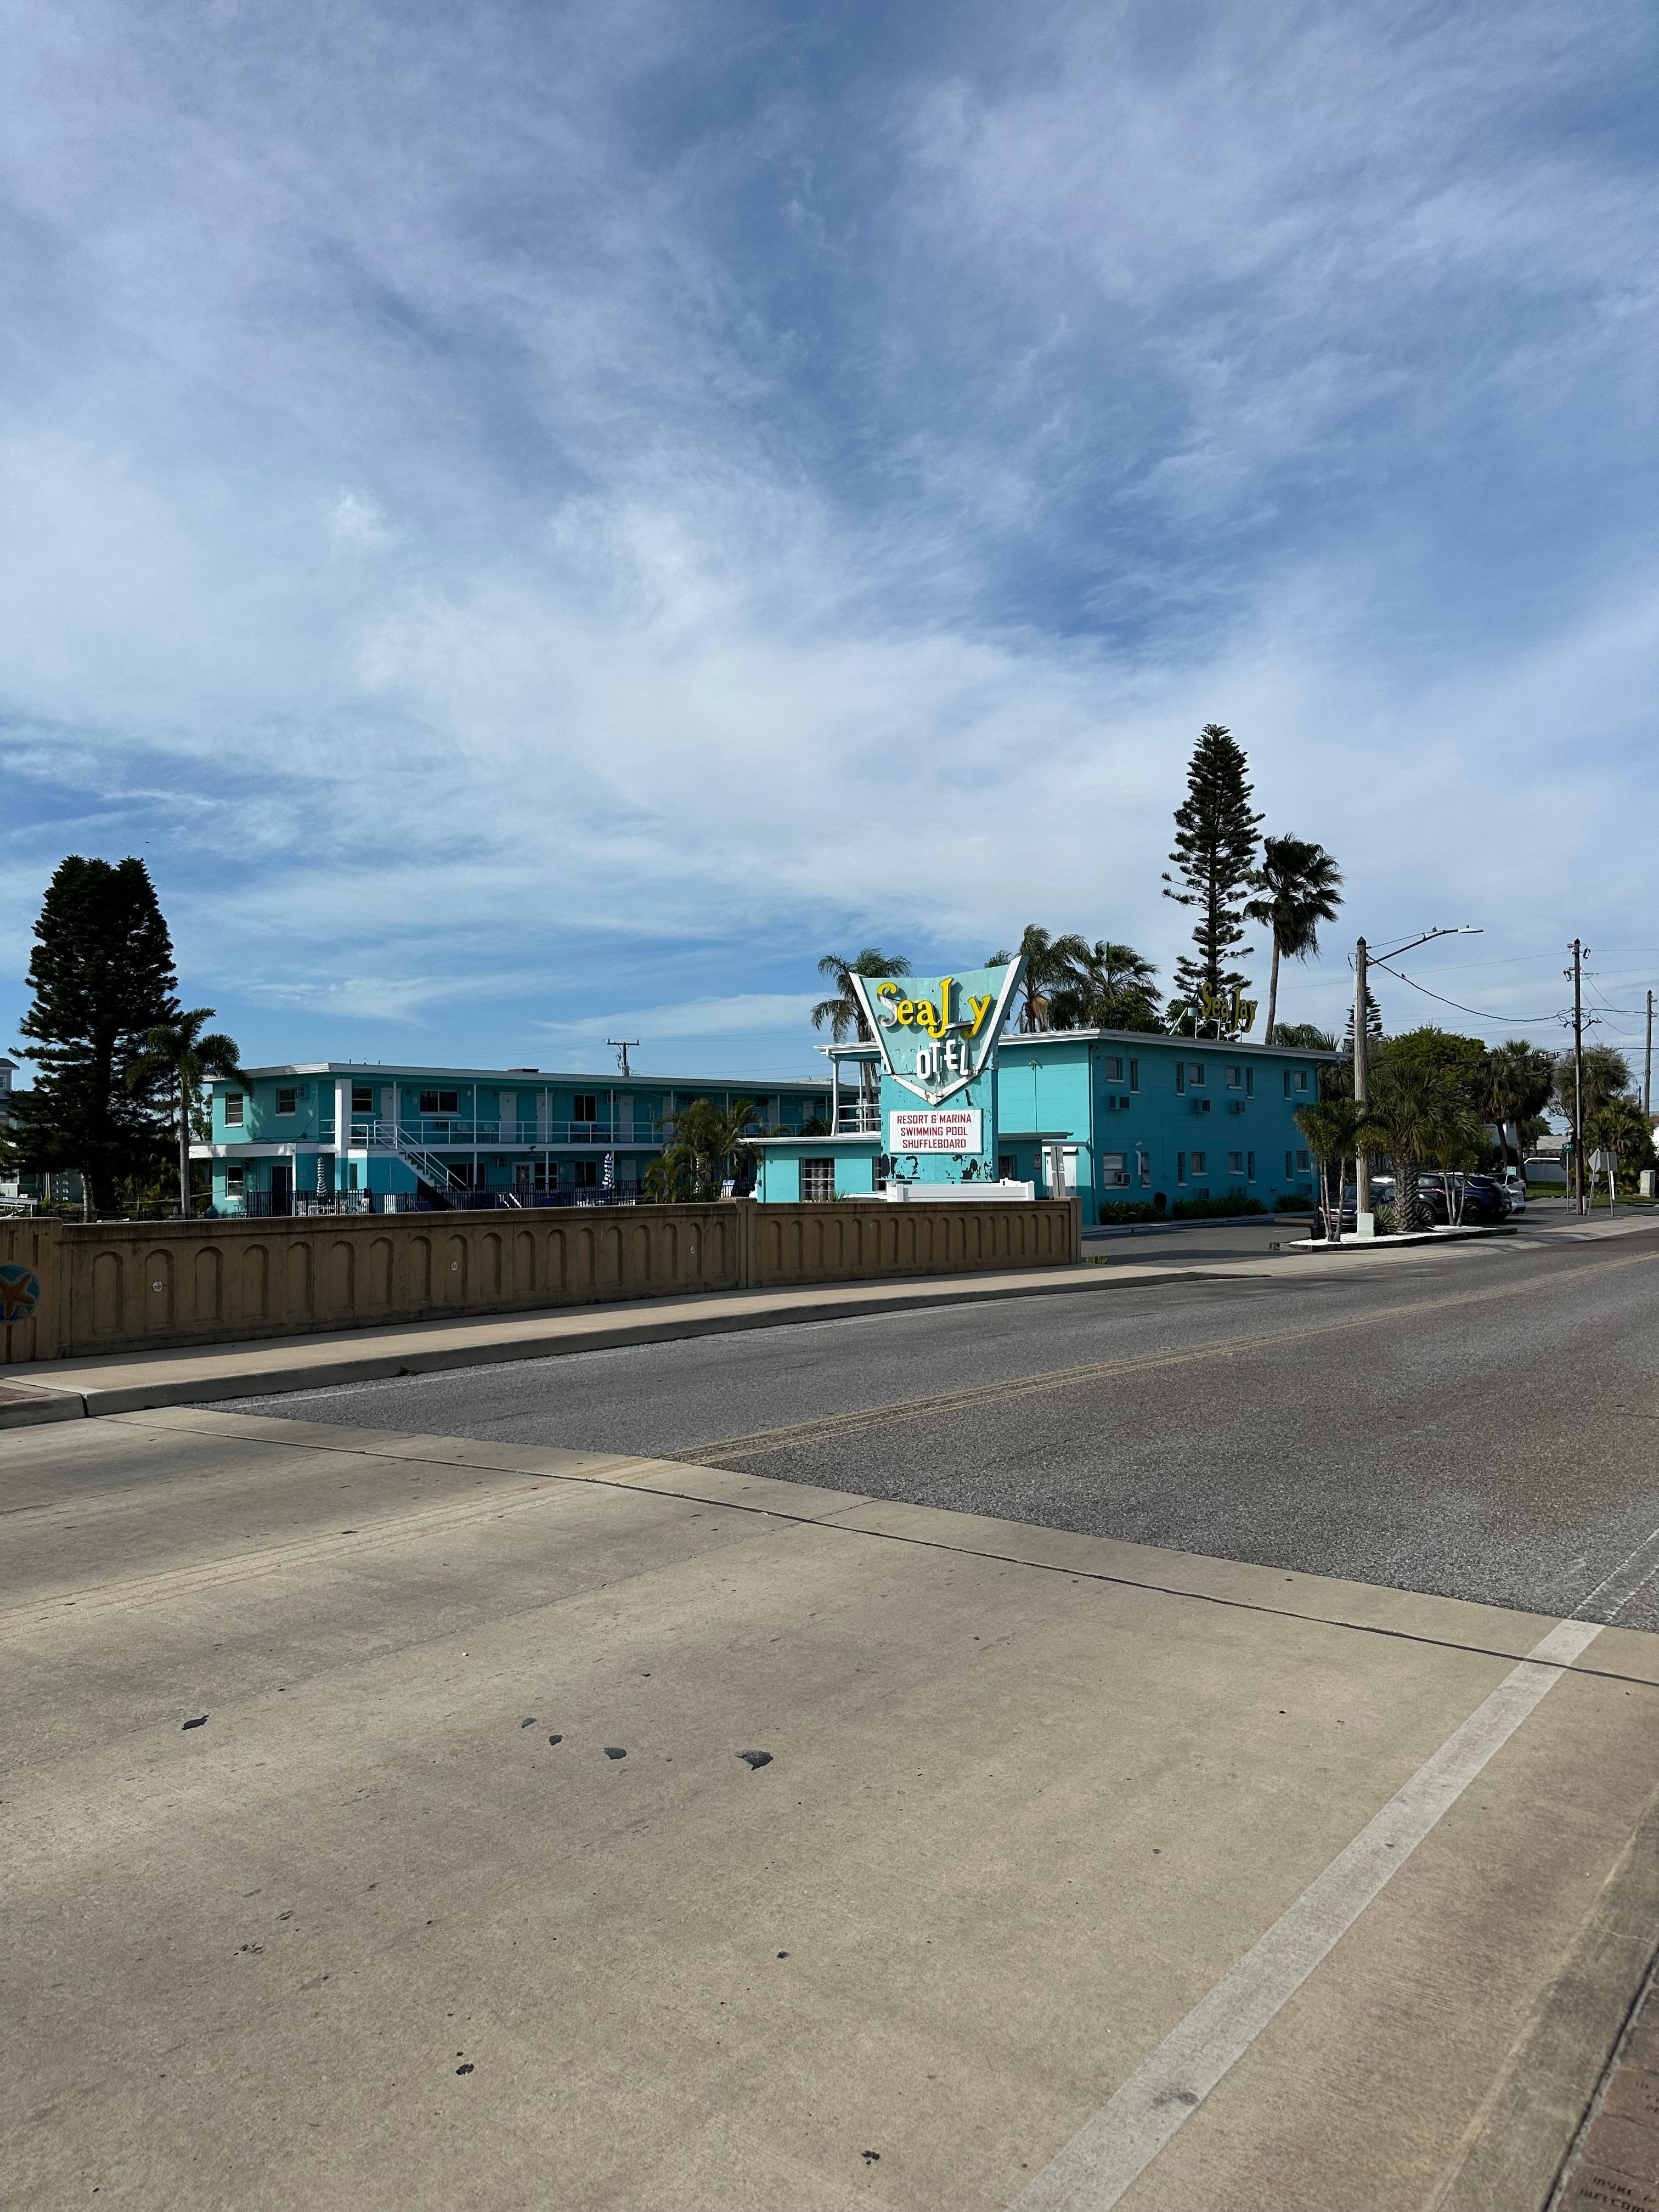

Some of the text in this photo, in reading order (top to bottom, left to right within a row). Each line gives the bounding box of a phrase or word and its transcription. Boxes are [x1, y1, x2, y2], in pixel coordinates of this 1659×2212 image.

[876, 982, 938, 1027] Sea
[1199, 982, 1257, 1033] Sea Jay
[916, 1039, 969, 1080] OTEL
[897, 1114, 972, 1124] RESORT & MARINA
[900, 1126, 968, 1136] SWIMMING POOL
[902, 1139, 966, 1148] SHUFFLEBOARD
